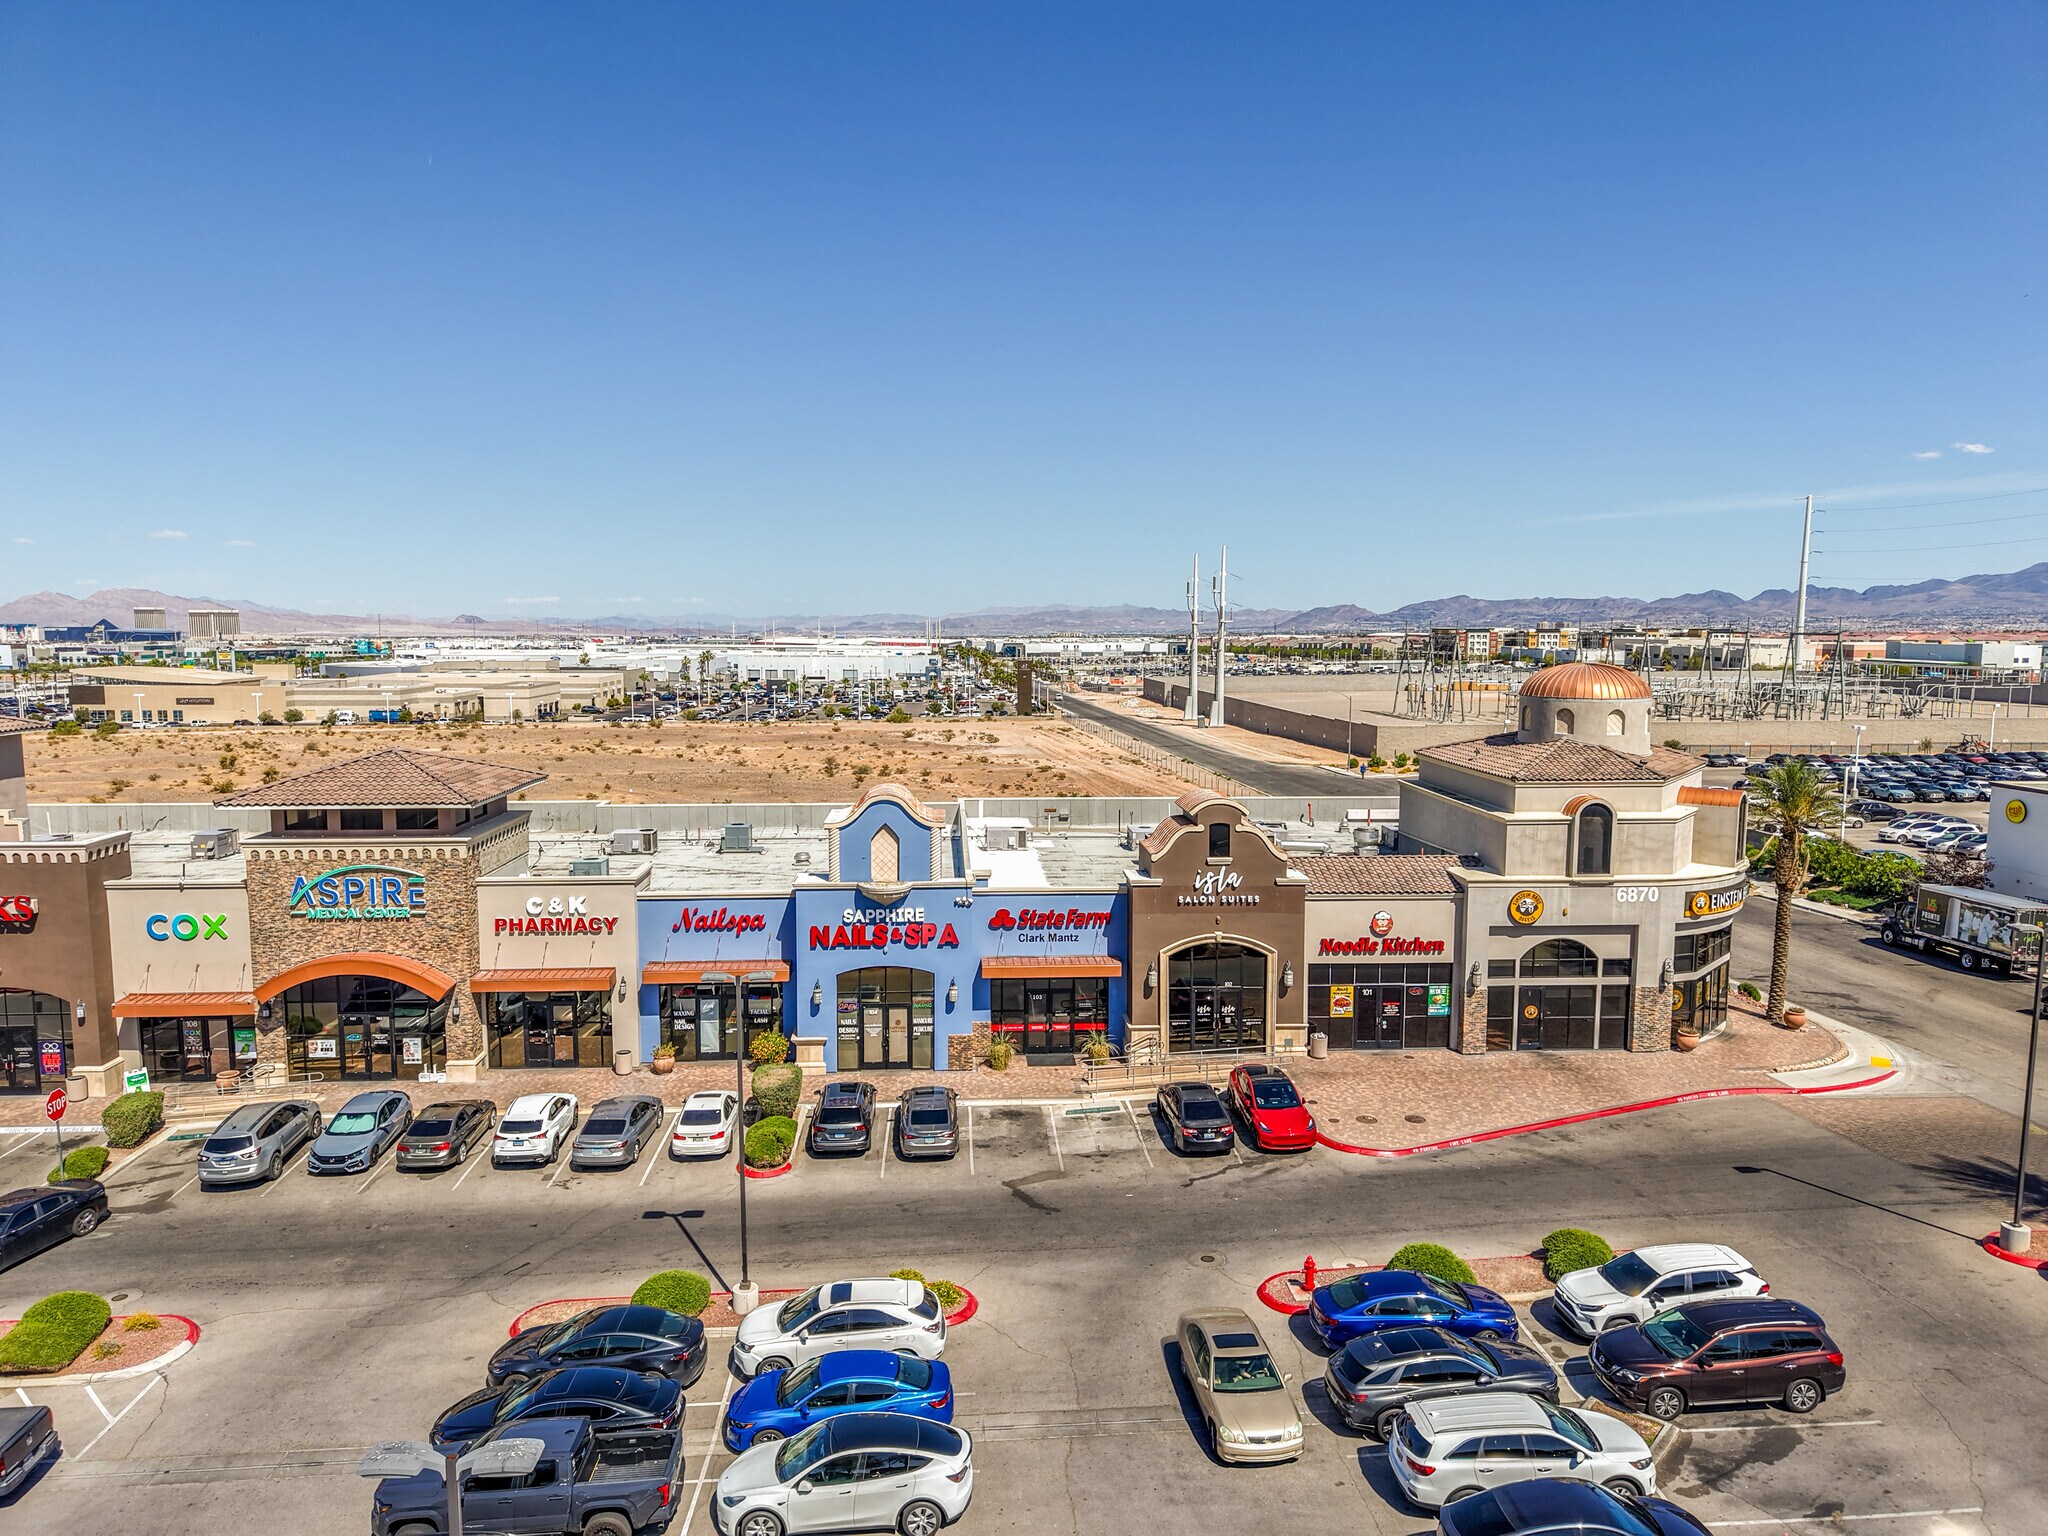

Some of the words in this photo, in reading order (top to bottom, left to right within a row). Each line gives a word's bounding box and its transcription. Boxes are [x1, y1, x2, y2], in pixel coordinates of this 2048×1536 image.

[289, 875, 426, 905] ASPIRE
[1194, 866, 1244, 895] isla
[1178, 895, 1216, 903] SALON
[1221, 895, 1260, 903] SUITES
[1616, 886, 1659, 903] 6870
[1712, 889, 1743, 909] EINSTEIN
[307, 907, 362, 919] MEDICAL
[363, 907, 411, 918] CENTER
[525, 896, 543, 915] C
[547, 896, 564, 913] &
[568, 895, 587, 914] K
[843, 907, 924, 923] SAPPHIRE
[146, 913, 228, 941] COX
[494, 916, 619, 933] PHARMACY
[672, 906, 766, 936] Nailspa
[810, 925, 889, 948] NAILS
[891, 927, 903, 941] &
[905, 923, 960, 947] SPA
[1018, 933, 1046, 943] Clark
[1048, 933, 1079, 943] Mantz
[1320, 937, 1380, 953] Noodle
[1382, 937, 1445, 953] Kitchen
[47, 1095, 66, 1115] STOP
